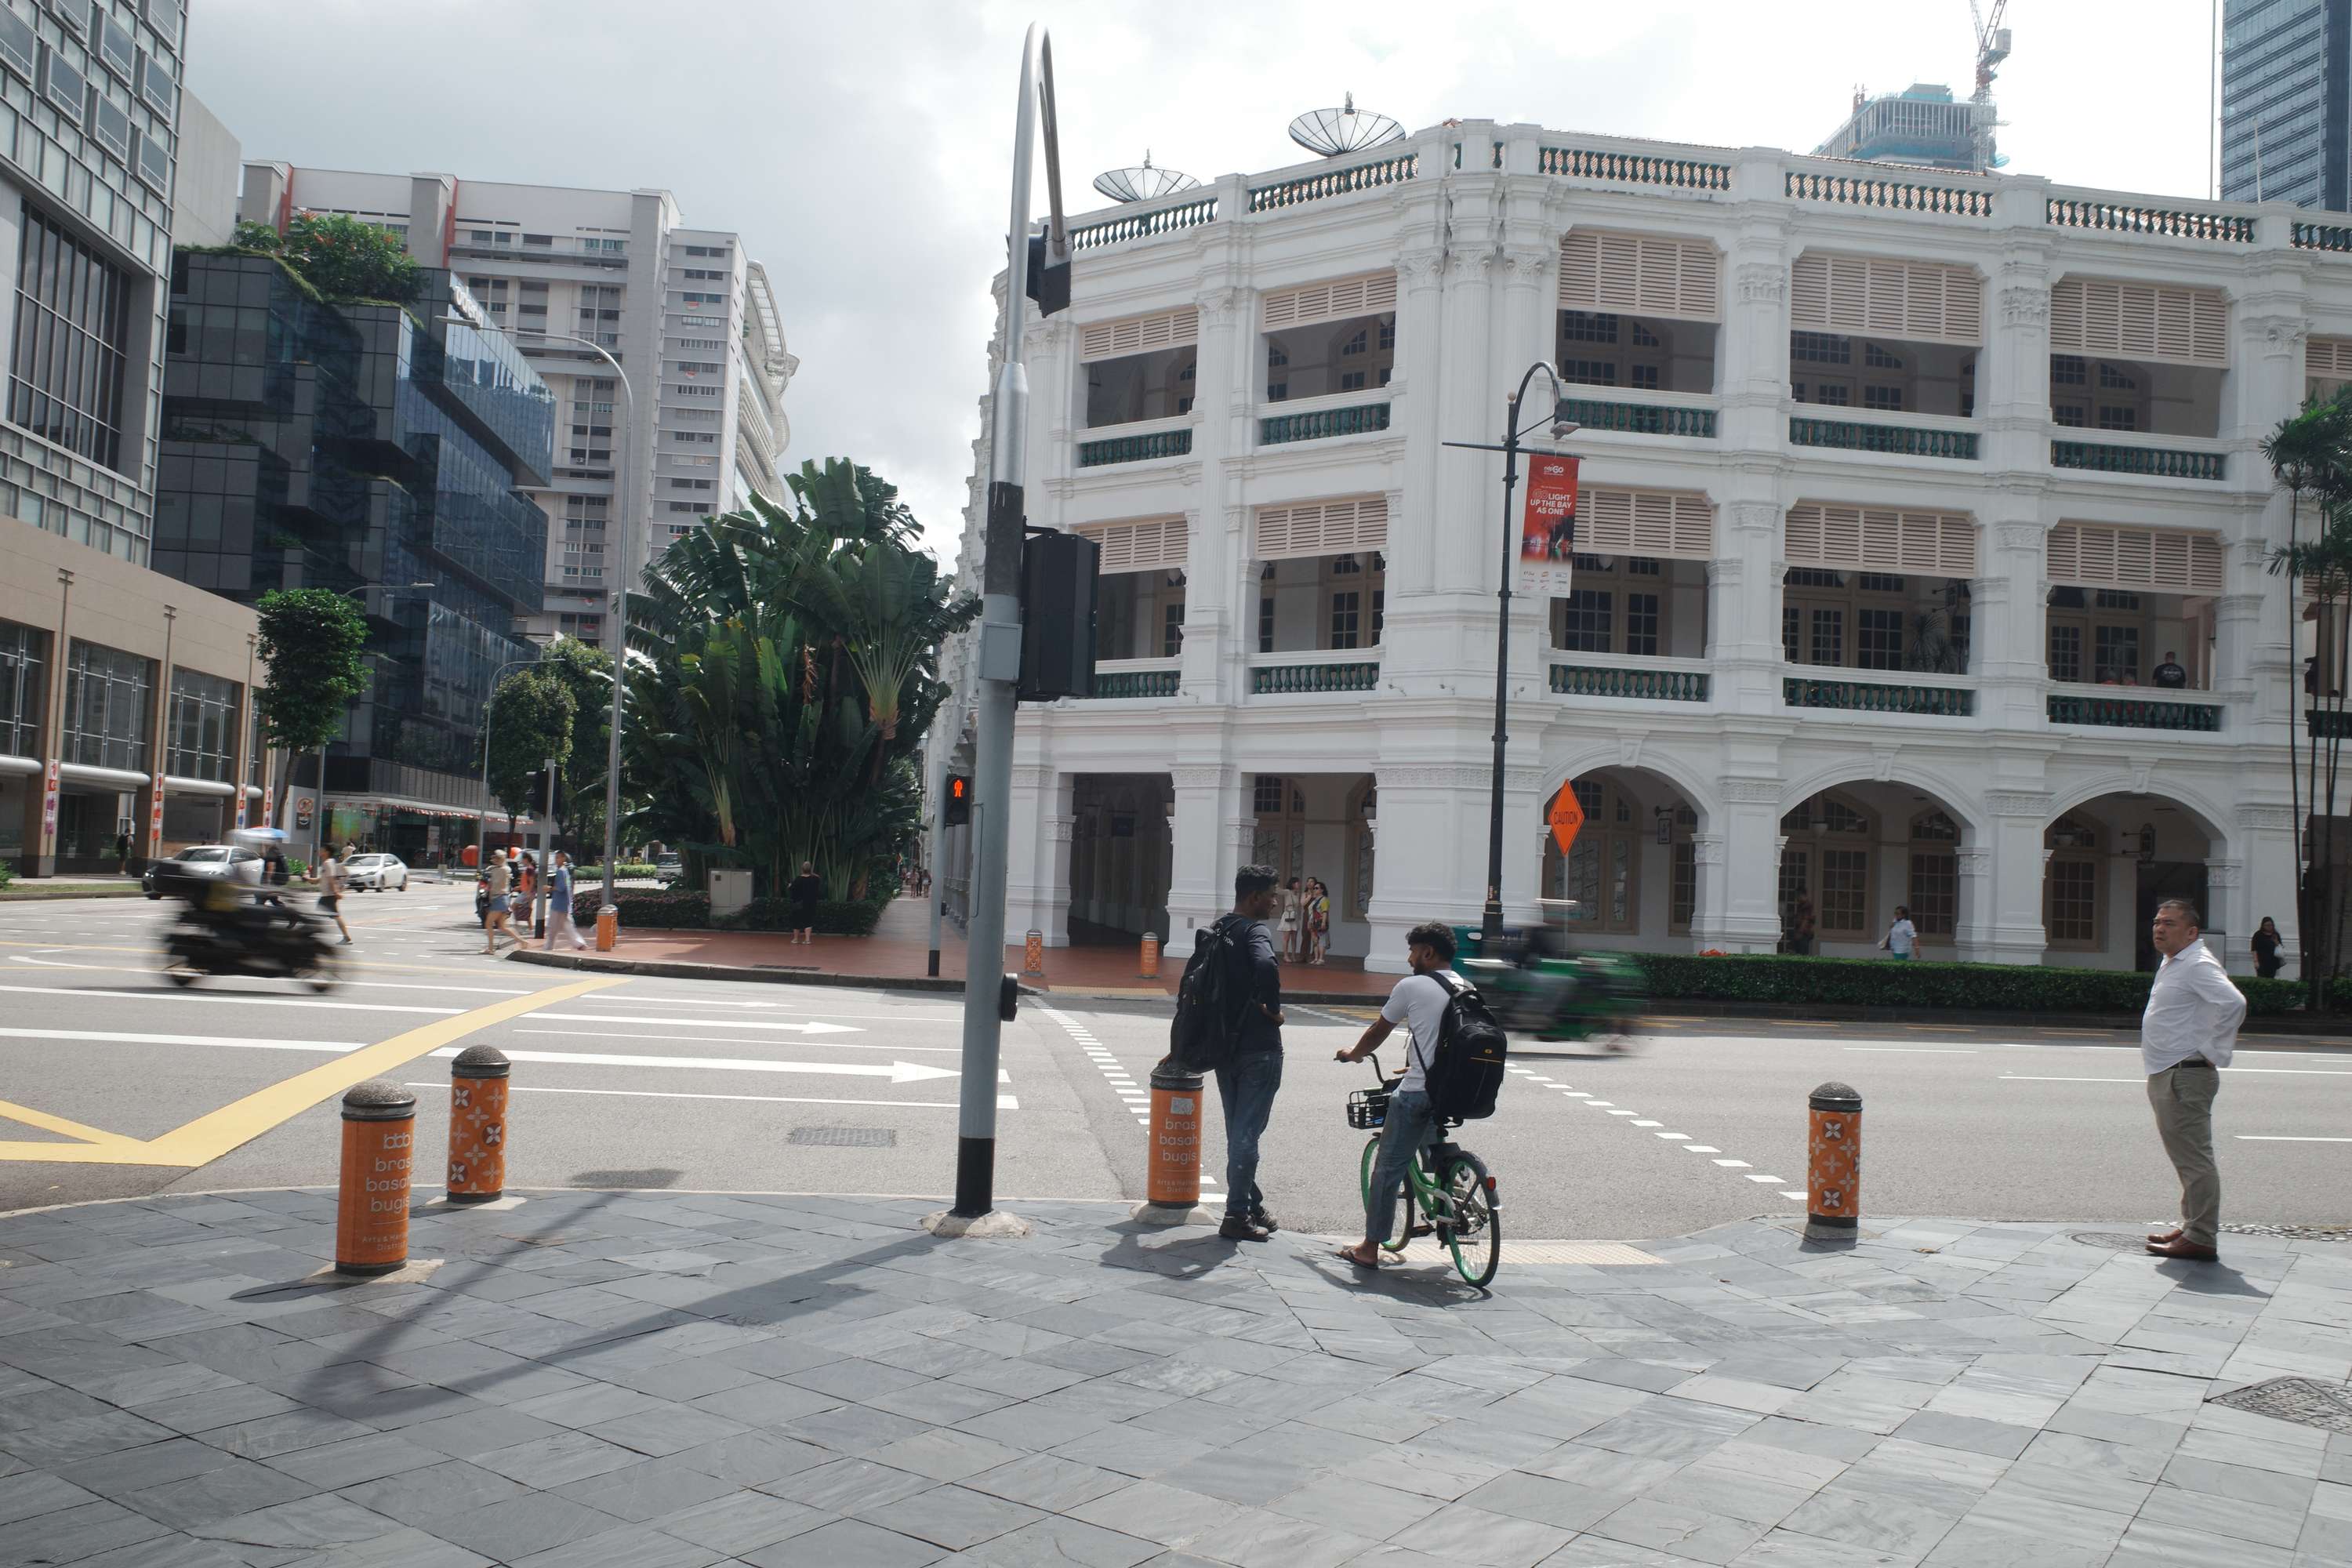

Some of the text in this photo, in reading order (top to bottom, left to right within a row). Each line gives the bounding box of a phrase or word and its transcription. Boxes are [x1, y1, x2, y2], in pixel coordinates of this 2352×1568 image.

[1554, 811, 1577, 825] CAUTION
[1165, 1117, 1196, 1130] bras
[376, 1156, 411, 1172] bras
[1162, 1149, 1197, 1165] bugis
[370, 1196, 410, 1214] bugis
